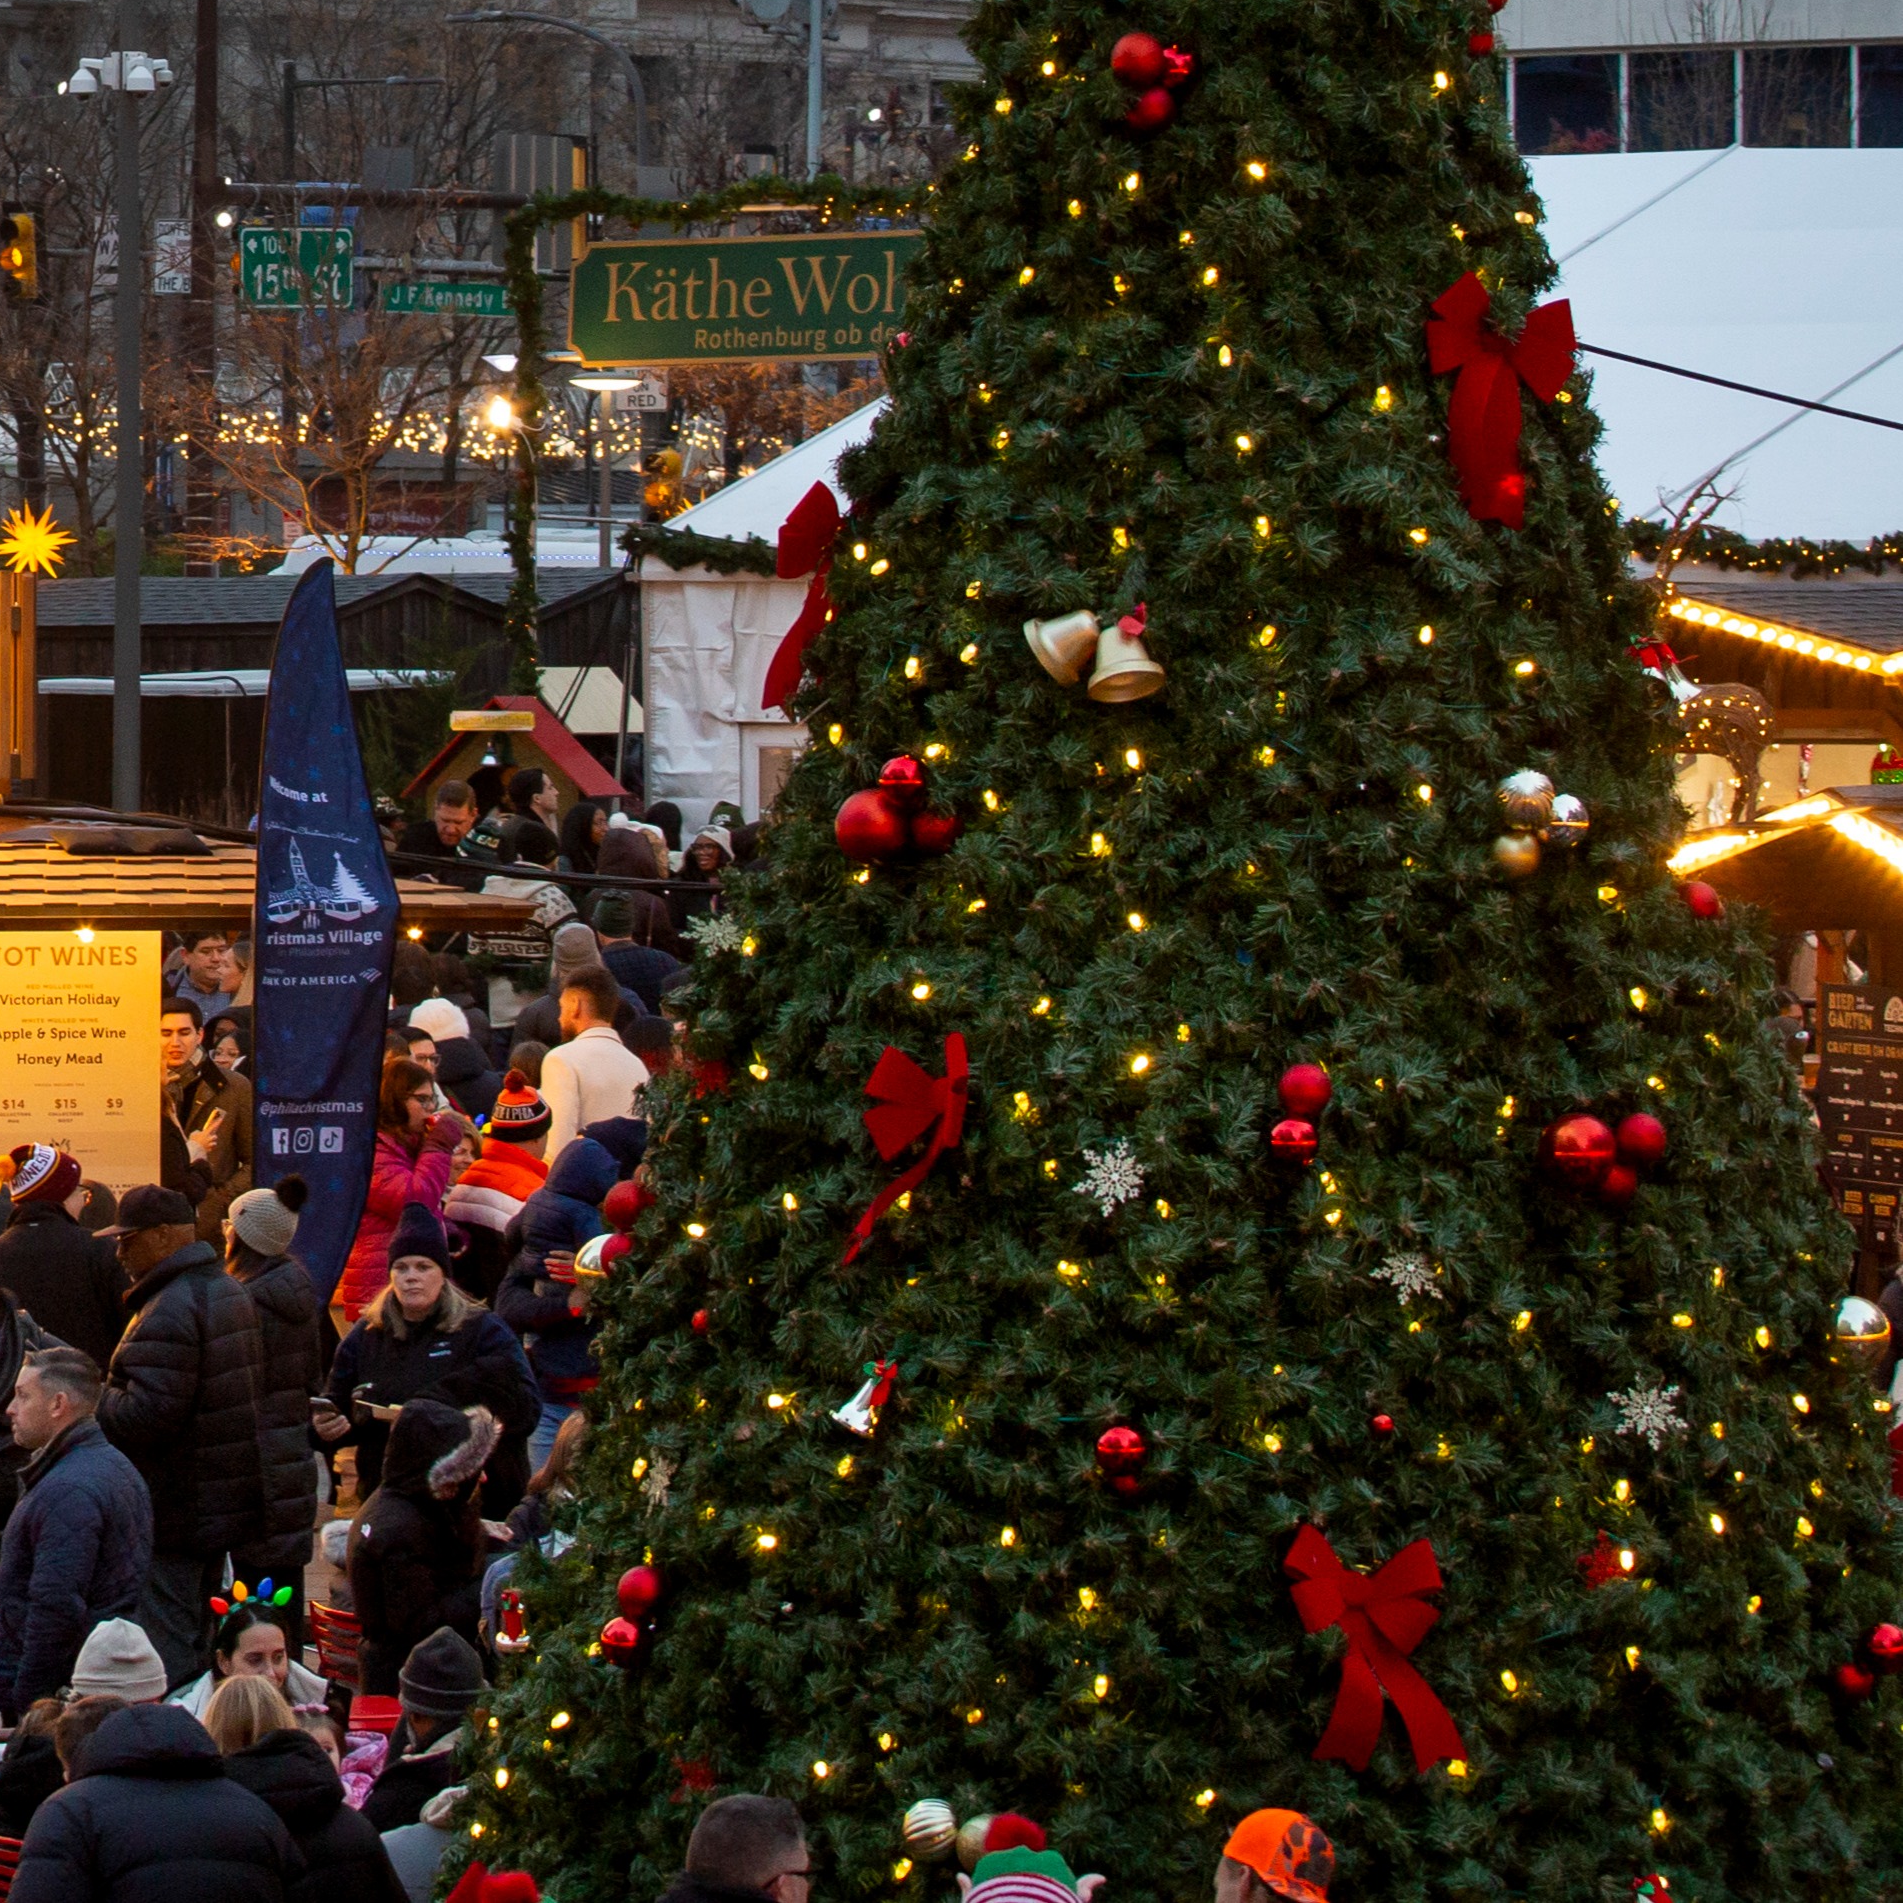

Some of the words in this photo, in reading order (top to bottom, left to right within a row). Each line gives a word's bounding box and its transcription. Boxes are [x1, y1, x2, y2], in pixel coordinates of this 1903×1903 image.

[603, 257, 772, 323] Käthe
[777, 251, 896, 317] Wol
[390, 286, 401, 305] J
[407, 286, 419, 305] F
[424, 286, 495, 312] Kennedy
[694, 328, 827, 352] Rothenburg
[834, 327, 862, 346] ob
[627, 394, 657, 407] RED
[312, 792, 329, 803] at
[328, 929, 383, 946] Village
[51, 946, 138, 966] WINES
[282, 977, 297, 986] OF
[300, 975, 357, 985] AMERICA
[0, 994, 63, 1006] Victorian
[68, 994, 121, 1007] Holiday
[1829, 992, 1855, 1010] BIER
[1829, 1010, 1872, 1030] GARTEN
[37, 1029, 46, 1039] &
[50, 1028, 87, 1041] Spice
[91, 1027, 127, 1039] Wine
[17, 1054, 61, 1067] Honey
[66, 1053, 103, 1064] Mead
[2, 1099, 25, 1110] $14
[54, 1099, 77, 1109] $15
[106, 1098, 124, 1109] $9
[260, 1101, 363, 1117] @philachristmas
